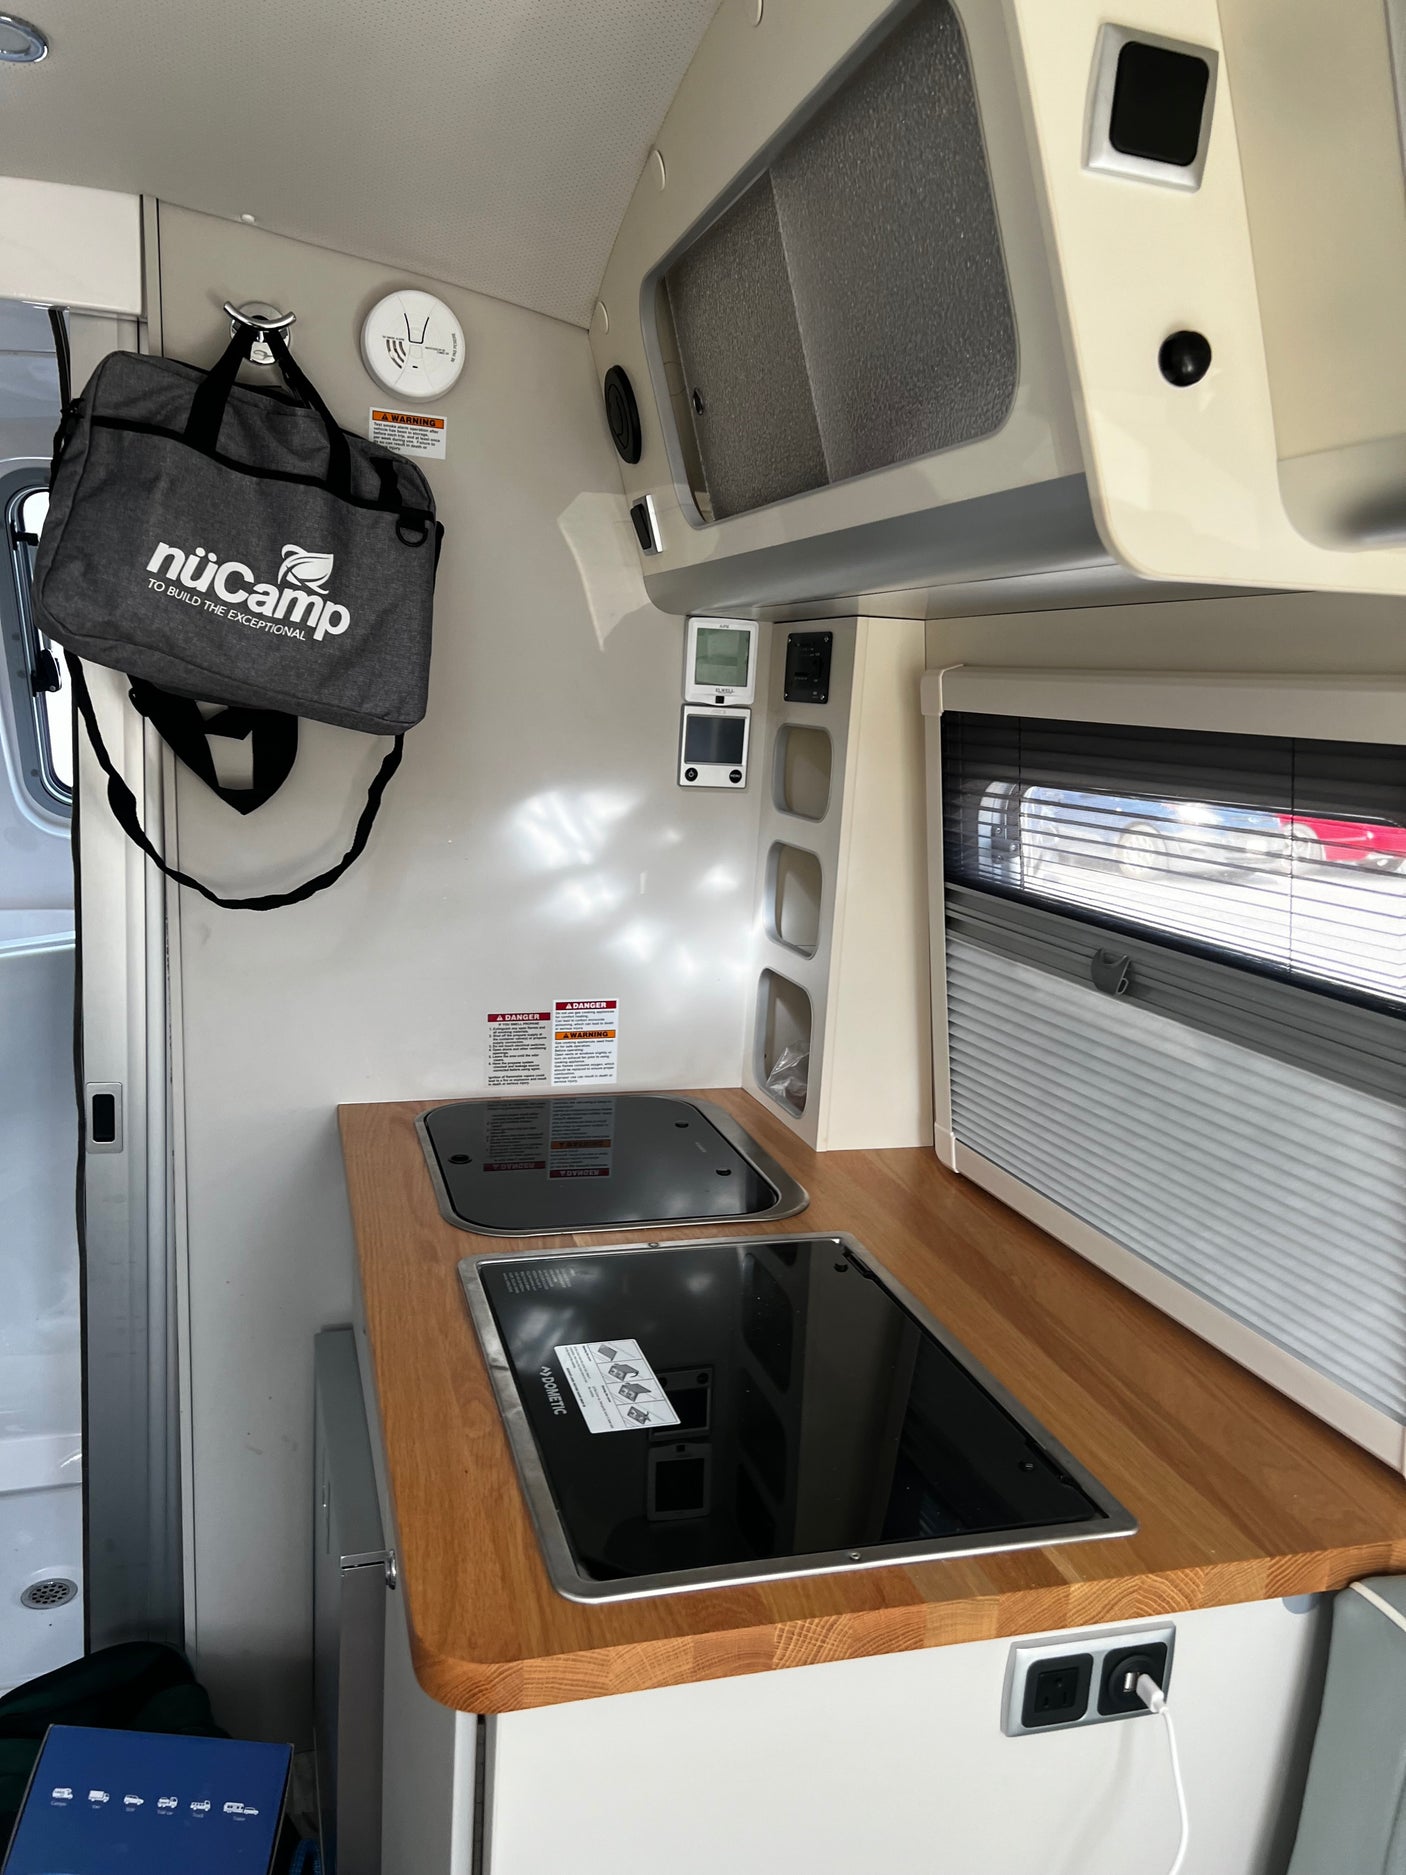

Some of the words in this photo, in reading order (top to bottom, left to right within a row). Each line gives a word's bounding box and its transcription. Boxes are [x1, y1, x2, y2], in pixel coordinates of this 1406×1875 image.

[391, 415, 436, 427] WARNING
[146, 541, 351, 642] nüCamp
[148, 578, 165, 592] TO
[167, 586, 201, 606] BUILD
[203, 600, 226, 617] THE
[227, 609, 306, 641] EXCEPTIONAL
[541, 1376, 568, 1415] DOMETIC
